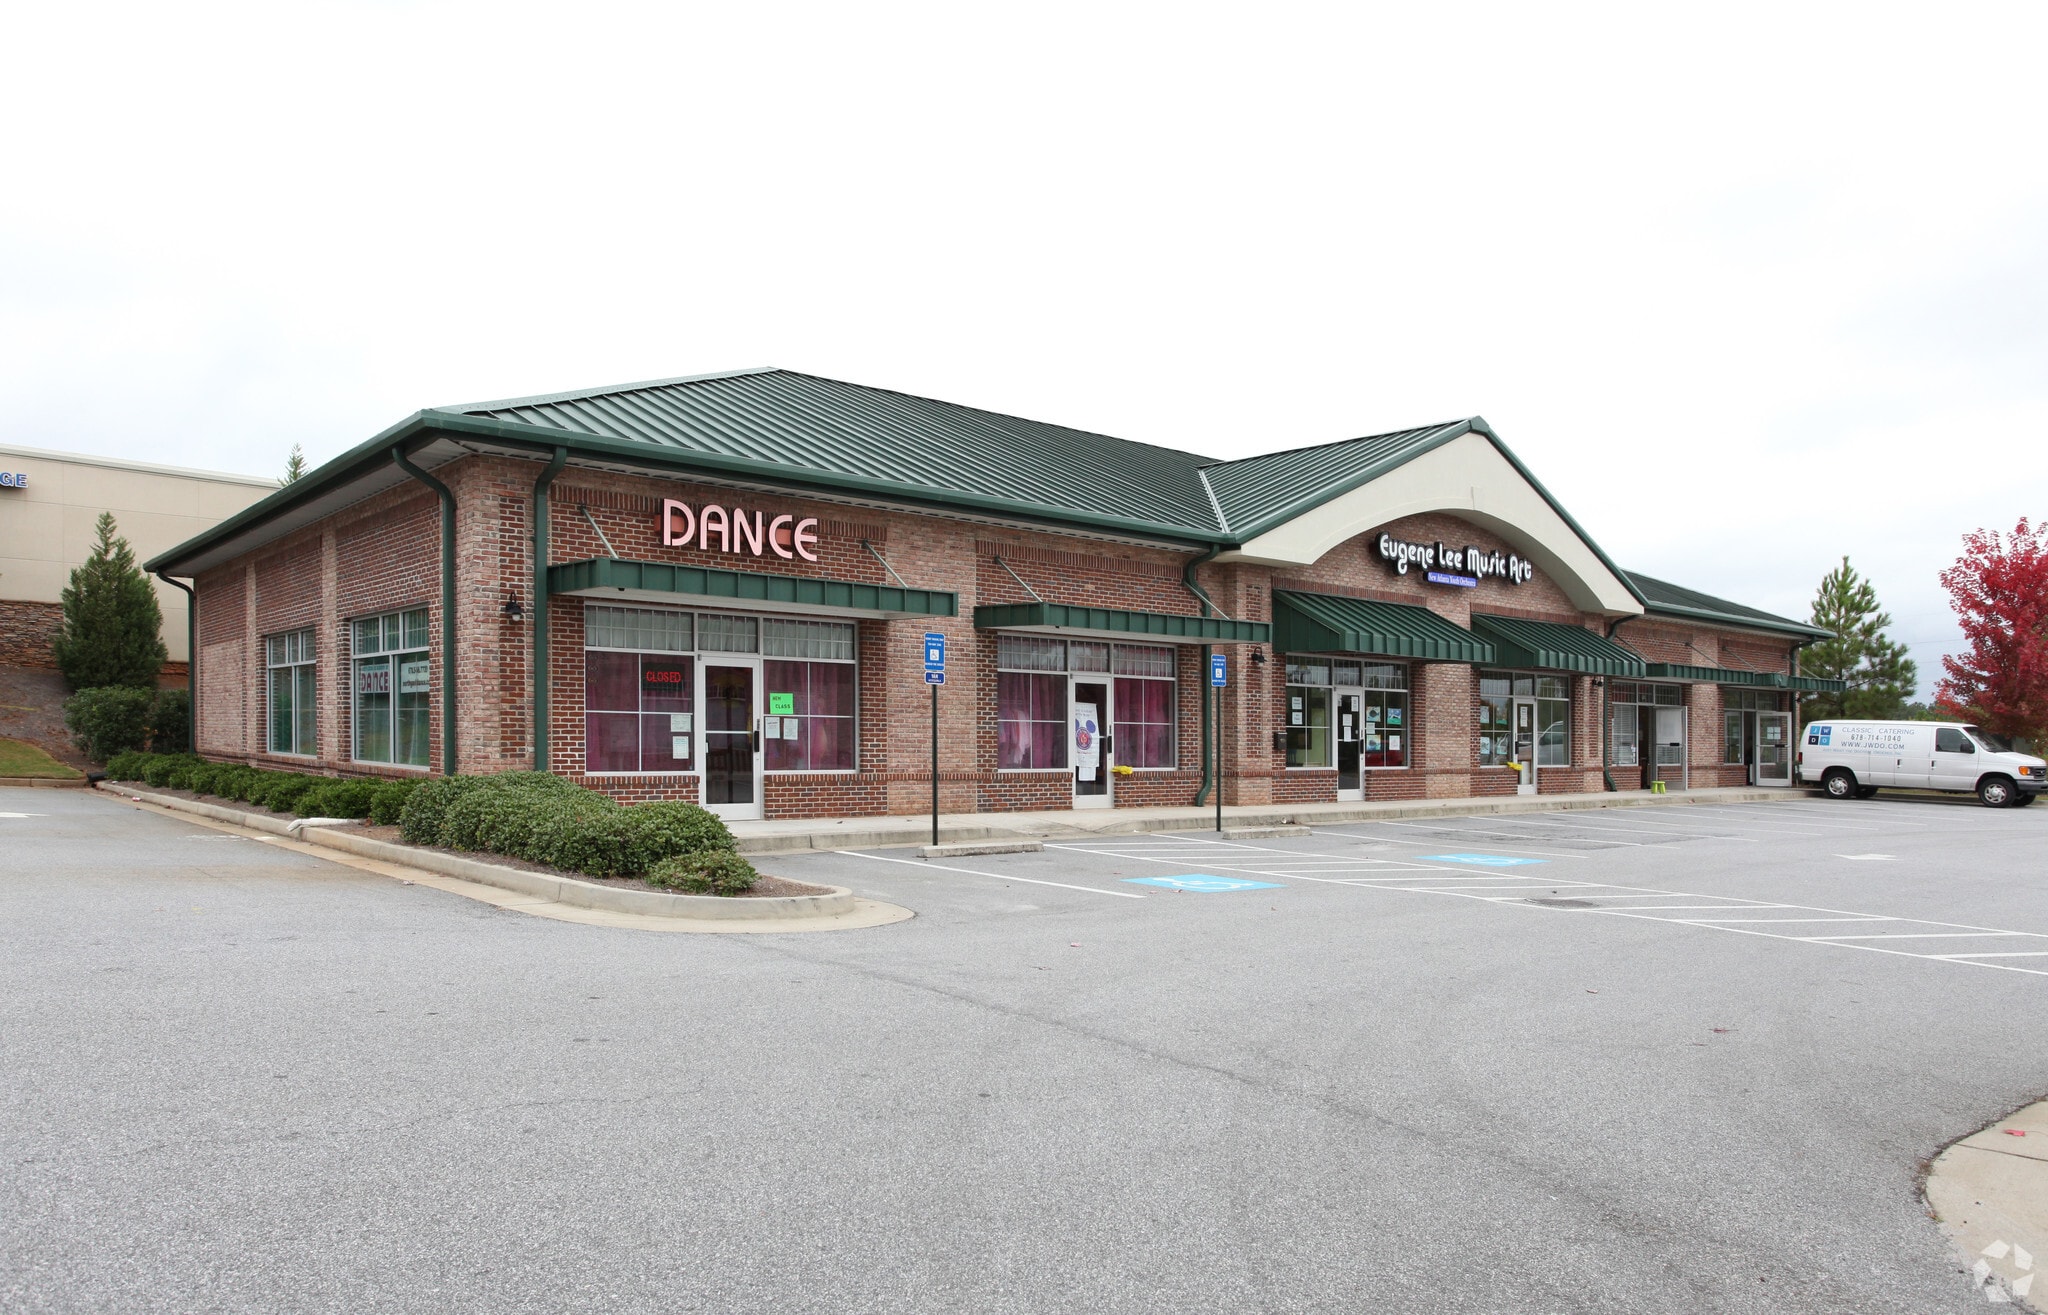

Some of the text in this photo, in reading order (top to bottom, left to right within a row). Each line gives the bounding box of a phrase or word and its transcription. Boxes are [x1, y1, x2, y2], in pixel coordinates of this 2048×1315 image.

[0, 472, 28, 488] GE
[664, 499, 818, 562] DANCE
[1380, 534, 1532, 584] Eugene Lee Music Art
[361, 671, 389, 692] DANCE
[646, 671, 682, 683] CLOSED
[1841, 741, 1905, 750] WWW.JWDO.COM
